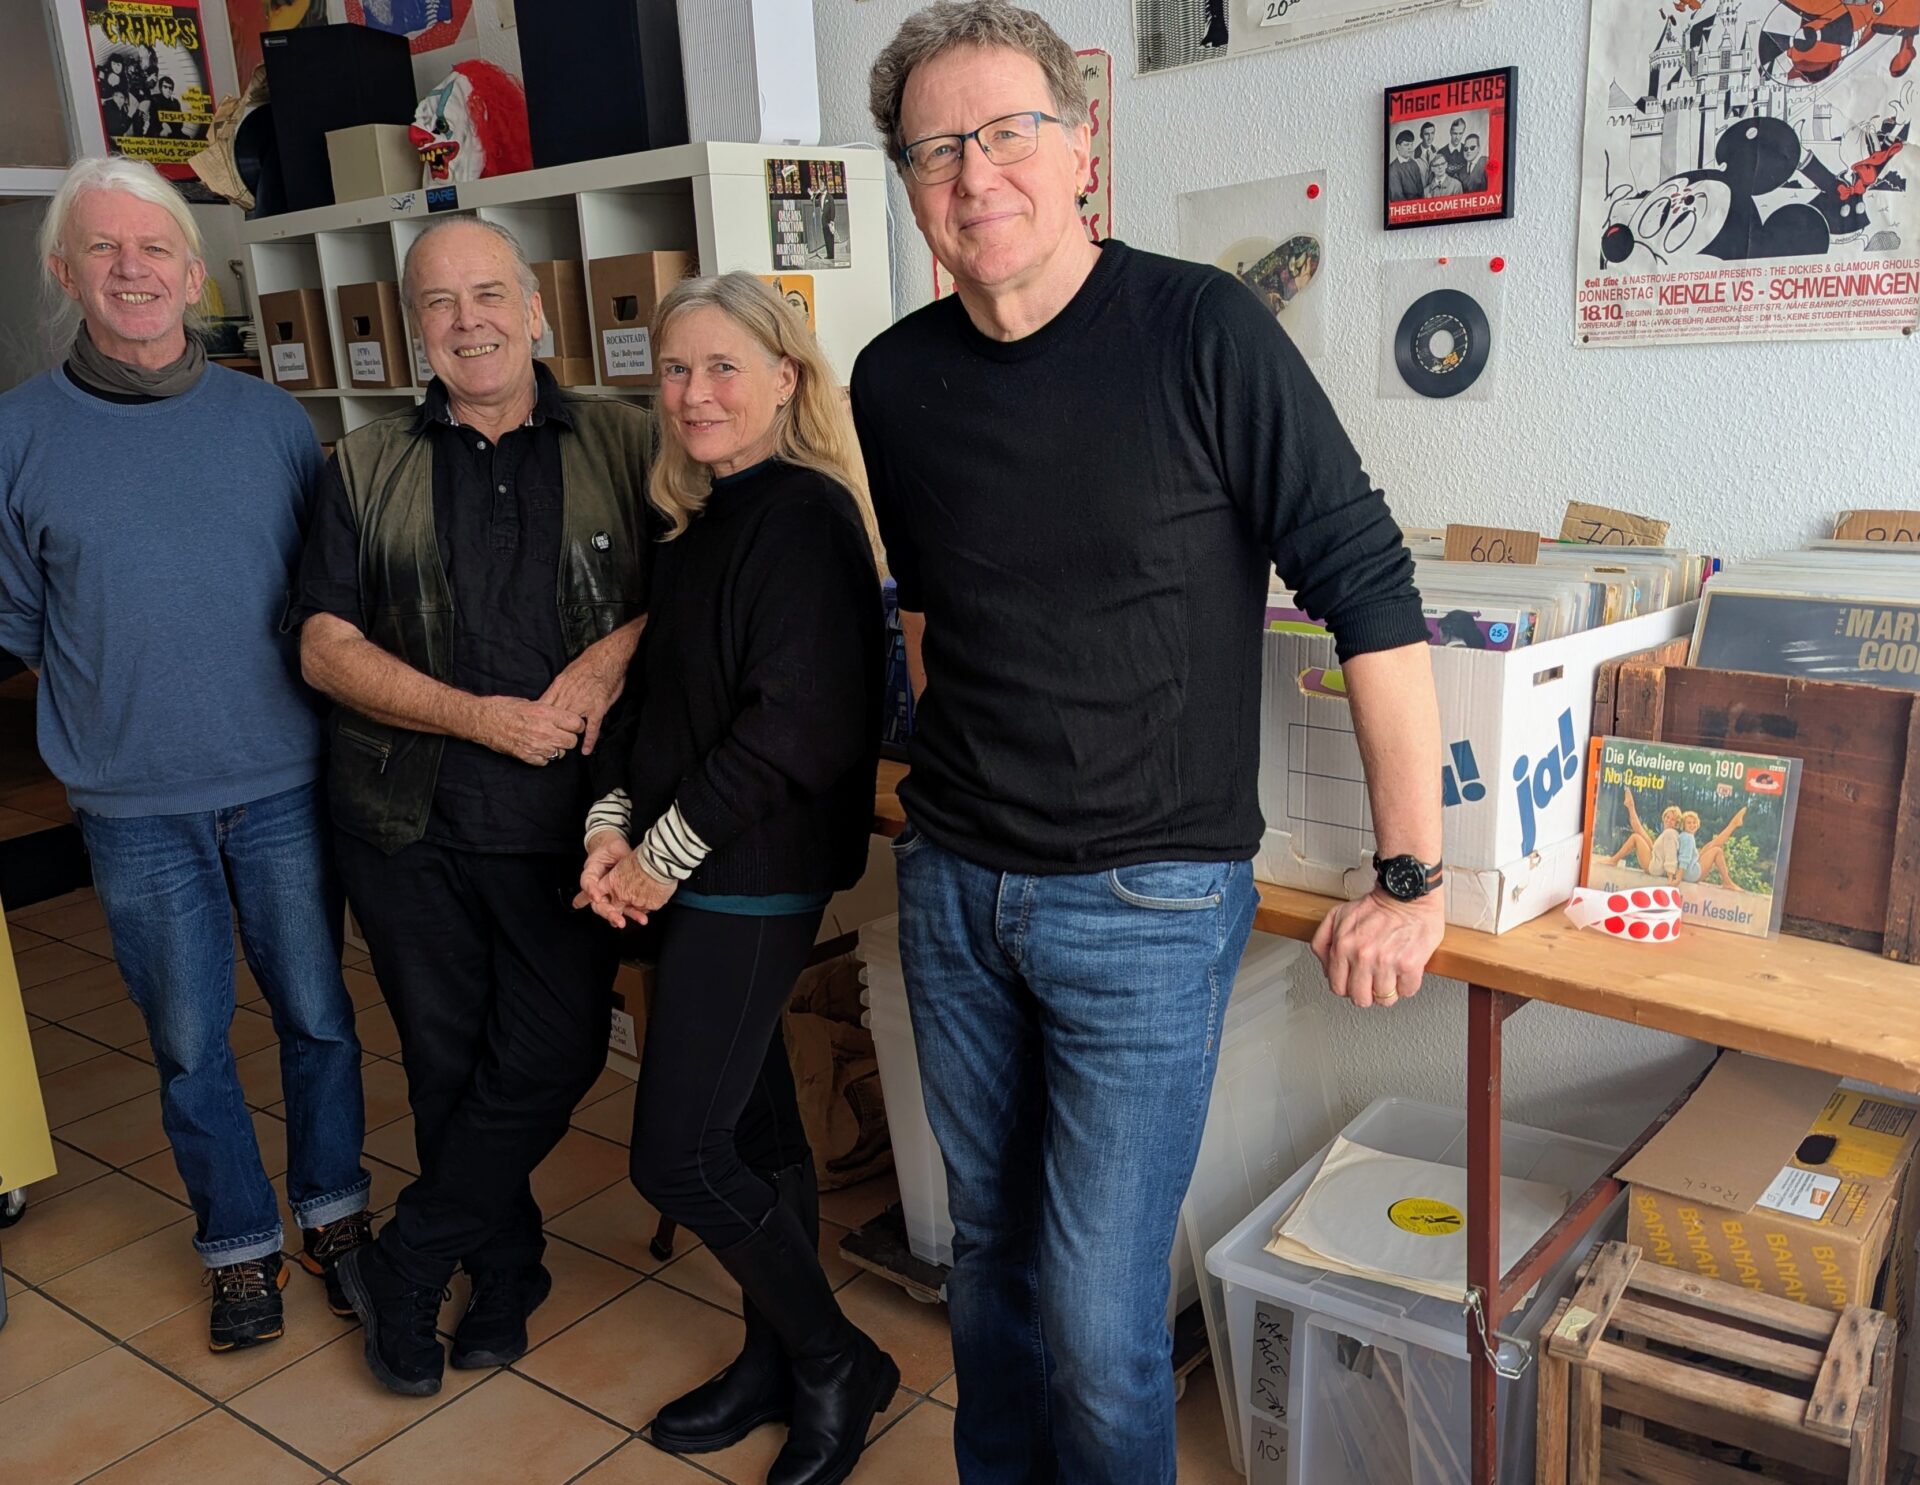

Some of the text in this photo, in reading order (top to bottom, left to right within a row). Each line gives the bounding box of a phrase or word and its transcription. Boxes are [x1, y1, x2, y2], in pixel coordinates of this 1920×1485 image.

[102, 11, 199, 50] CRAMPS
[1390, 76, 1506, 117] MAGIC HERBS
[159, 112, 213, 123] JESUS JONES
[122, 146, 175, 156] VOLKSHAUS
[778, 210, 802, 222] ORLEANS
[783, 200, 796, 210] NEW
[1390, 202, 1428, 217] THERE'LL
[1428, 198, 1459, 213] COME
[1459, 195, 1478, 209] THE
[1479, 193, 1502, 207] DAY
[778, 221, 804, 232] FUNCTION
[784, 232, 800, 244] LOUIS
[776, 244, 809, 255] ARMSTRONG
[782, 255, 791, 266] ALL
[1629, 273, 1676, 285] NASTROVJE
[1677, 270, 1718, 282] POTSDAM
[1719, 267, 1762, 279] PRESENTS
[1770, 266, 1786, 276] THE
[1788, 264, 1823, 275] DICKIES
[1825, 264, 1832, 273] &
[1834, 260, 1880, 272] GLAMOUR
[1882, 258, 1920, 270] GHOULS
[1579, 286, 1654, 303] DONNERSTAG
[1658, 282, 1726, 306] KIENZLE
[1731, 280, 1754, 302] VS
[1768, 272, 1920, 301] SCHWENNINGEN
[1626, 309, 1652, 318] BEGINN
[1656, 308, 1673, 316] 20.00
[1673, 308, 1689, 316] UHR
[1787, 300, 1810, 310] NÄHE
[1810, 300, 1848, 309] BAHNHOF
[1852, 296, 1920, 307] SCHWENNINGEN
[1578, 320, 1622, 330] VORVERKAUF
[1626, 320, 1638, 328] DM
[1704, 314, 1754, 324] ABENDKASSE
[1760, 314, 1772, 322] DM
[1786, 312, 1810, 321] KEINE
[1812, 308, 1918, 320] STUDENTENERMÄSSIGUNG
[606, 333, 647, 345] ROCKSTEADY
[1834, 607, 1847, 636] THE
[1604, 746, 1744, 780] Die Kavaliere von 1910
[1512, 706, 1578, 858] ja!
[1604, 767, 1621, 784] No
[1702, 900, 1753, 924] Kessler
